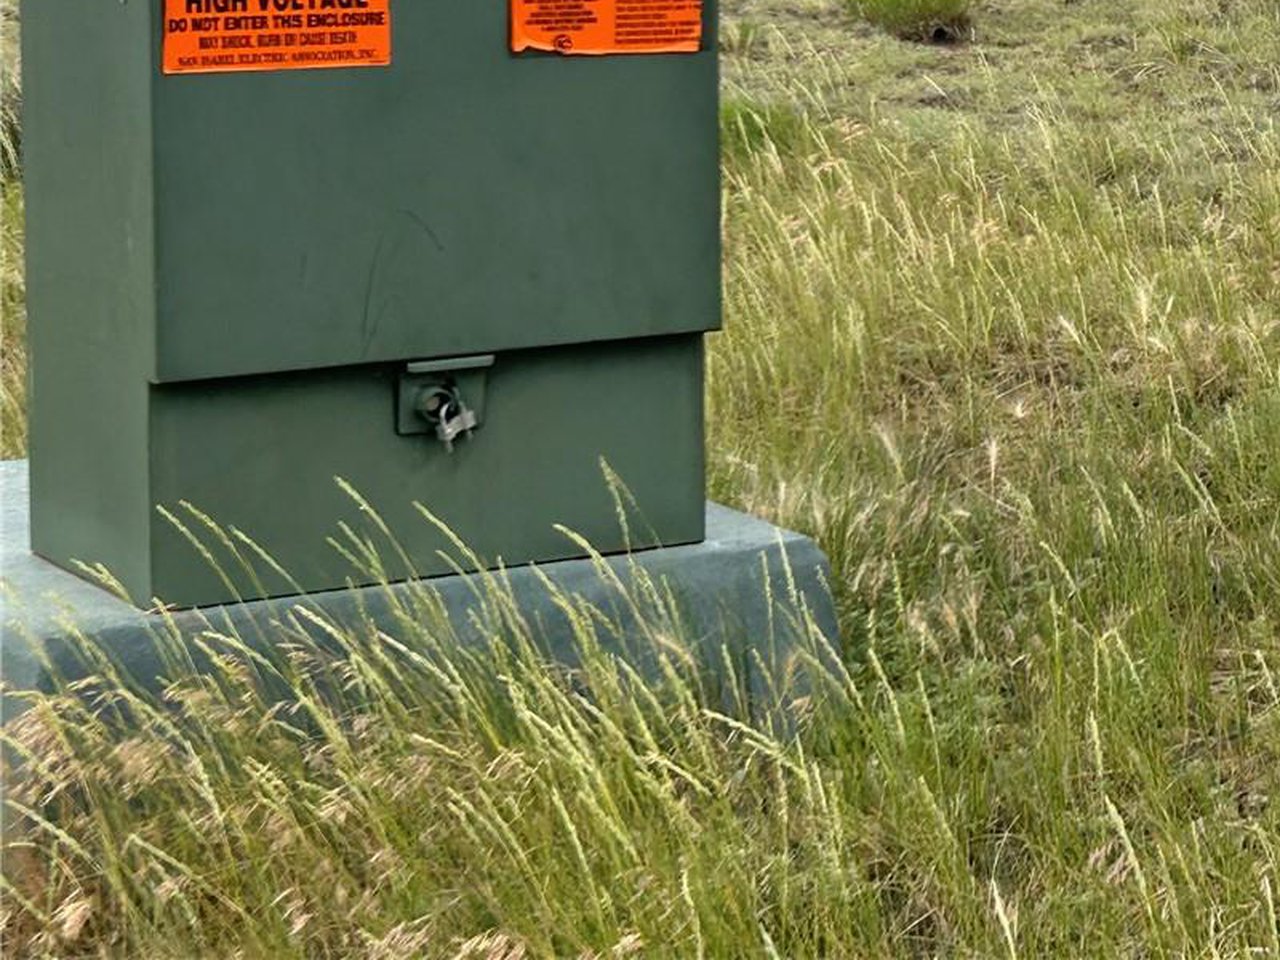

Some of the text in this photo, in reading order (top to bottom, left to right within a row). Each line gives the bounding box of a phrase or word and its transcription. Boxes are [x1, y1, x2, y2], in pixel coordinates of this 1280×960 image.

[168, 11, 385, 33] DO NOT ENTER THIS ENCLOSURE
